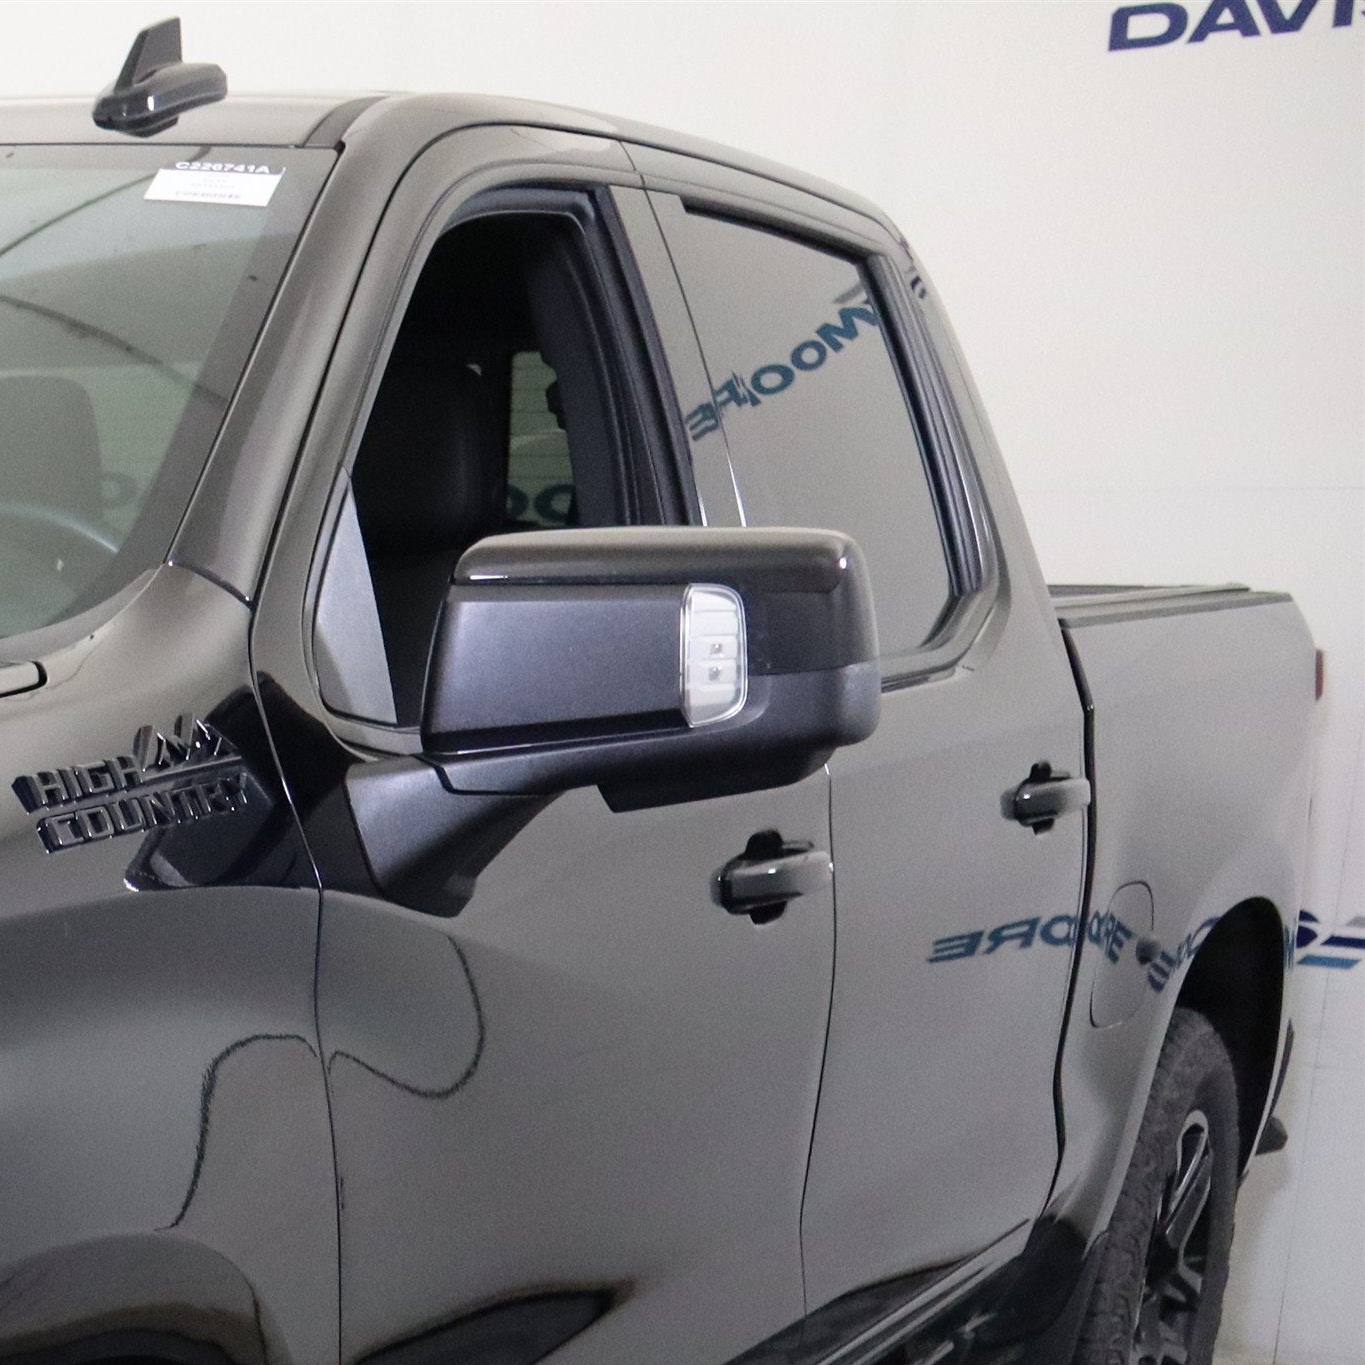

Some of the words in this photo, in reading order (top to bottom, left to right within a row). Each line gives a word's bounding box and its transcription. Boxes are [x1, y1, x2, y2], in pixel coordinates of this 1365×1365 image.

[1107, 0, 1365, 52] DAVI
[11, 755, 145, 815] HIGH
[36, 772, 249, 854] COUNTRY
